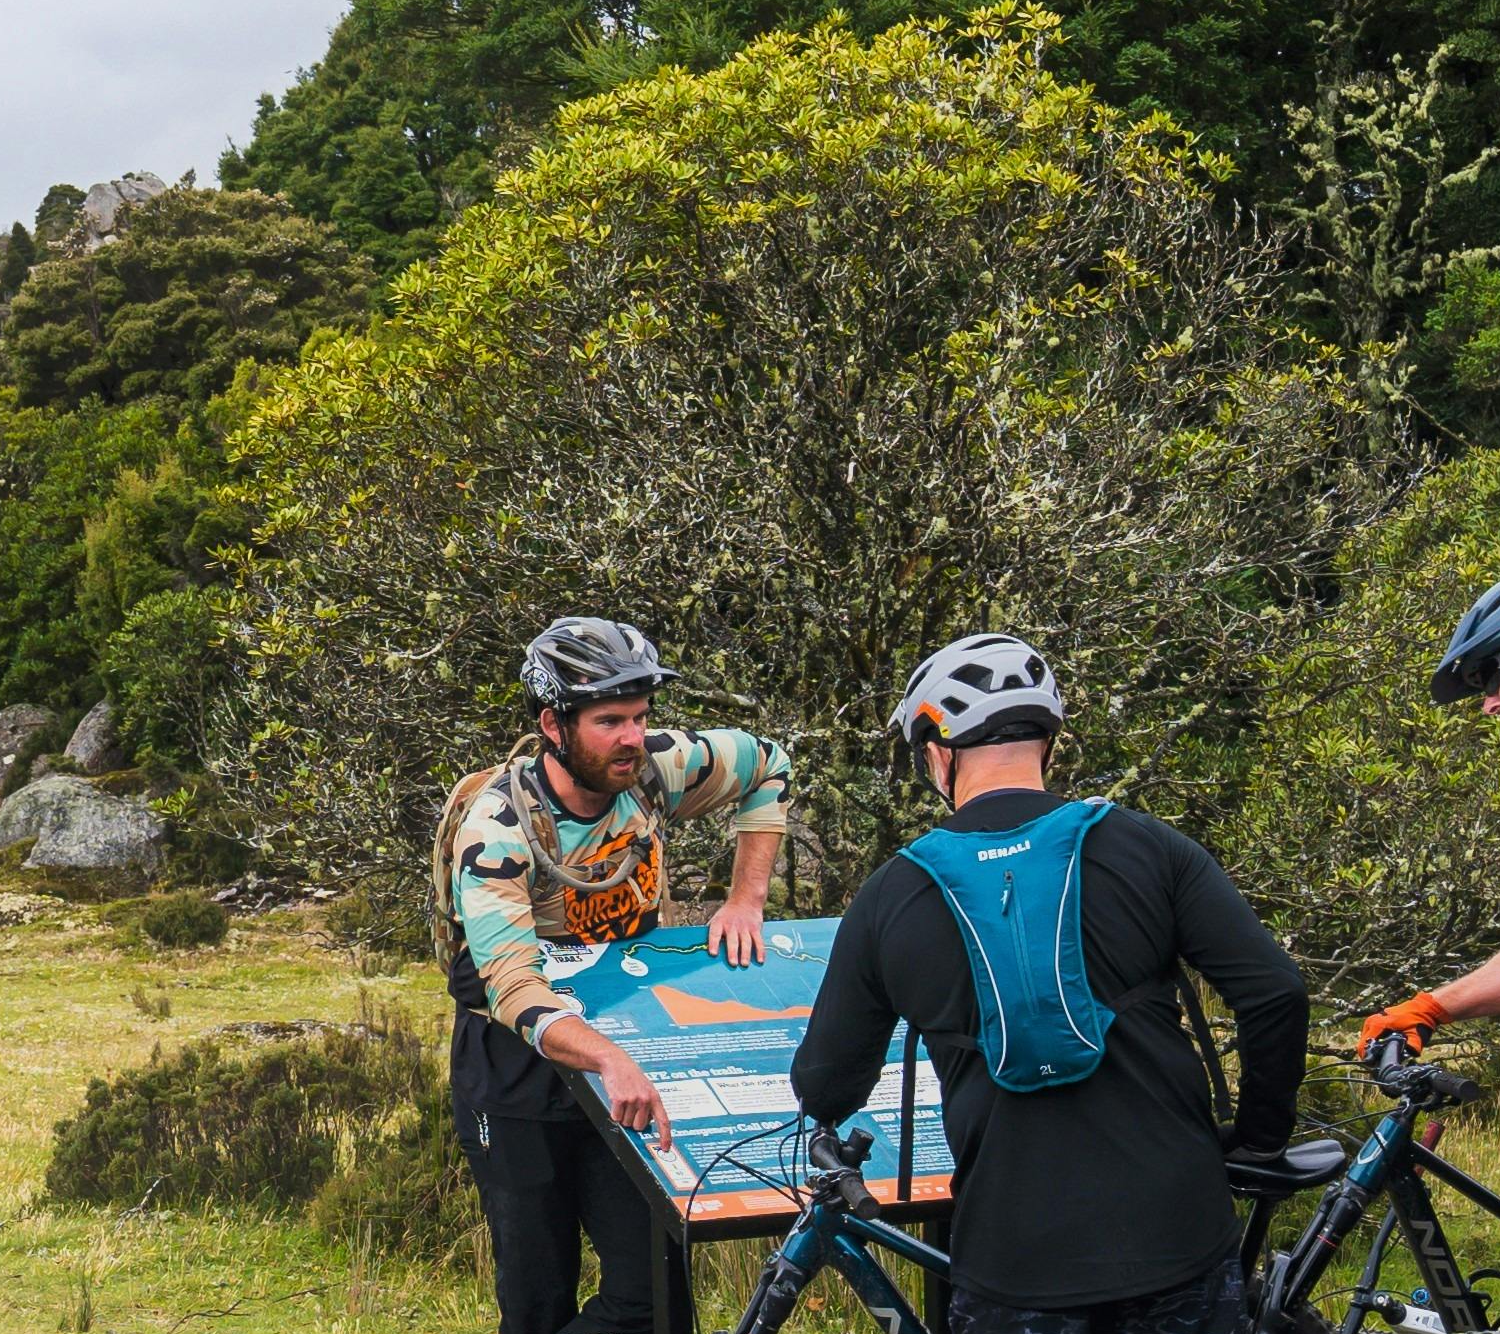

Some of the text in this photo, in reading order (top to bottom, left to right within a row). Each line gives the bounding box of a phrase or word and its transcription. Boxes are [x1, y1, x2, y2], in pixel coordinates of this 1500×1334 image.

[977, 839, 1031, 862] DENALI
[671, 1071, 689, 1080] on
[688, 1069, 710, 1078] the
[1039, 1064, 1057, 1076] 2L
